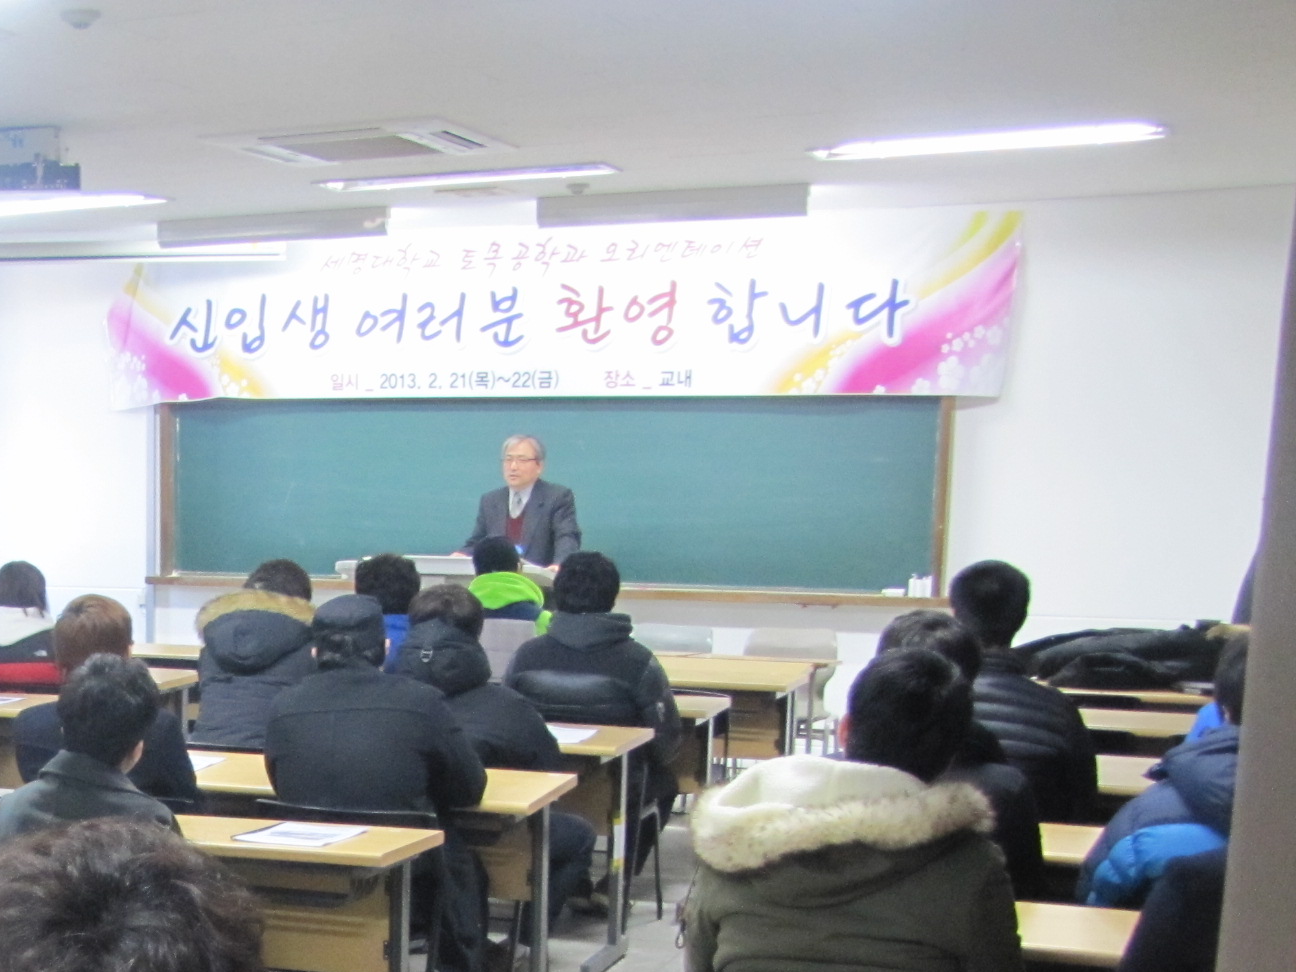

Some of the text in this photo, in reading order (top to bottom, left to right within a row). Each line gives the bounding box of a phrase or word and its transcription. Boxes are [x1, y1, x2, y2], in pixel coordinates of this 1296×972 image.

[320, 236, 764, 279] 세명대학교 토목공학과 오리엔테이션
[169, 277, 911, 354] 신입생 여러분 환영 합니다
[330, 373, 359, 392] 일시
[379, 372, 422, 390] 2013.
[449, 369, 560, 391] 21(목)~22(금)
[604, 369, 637, 390] 장소
[658, 368, 693, 388] 교내
